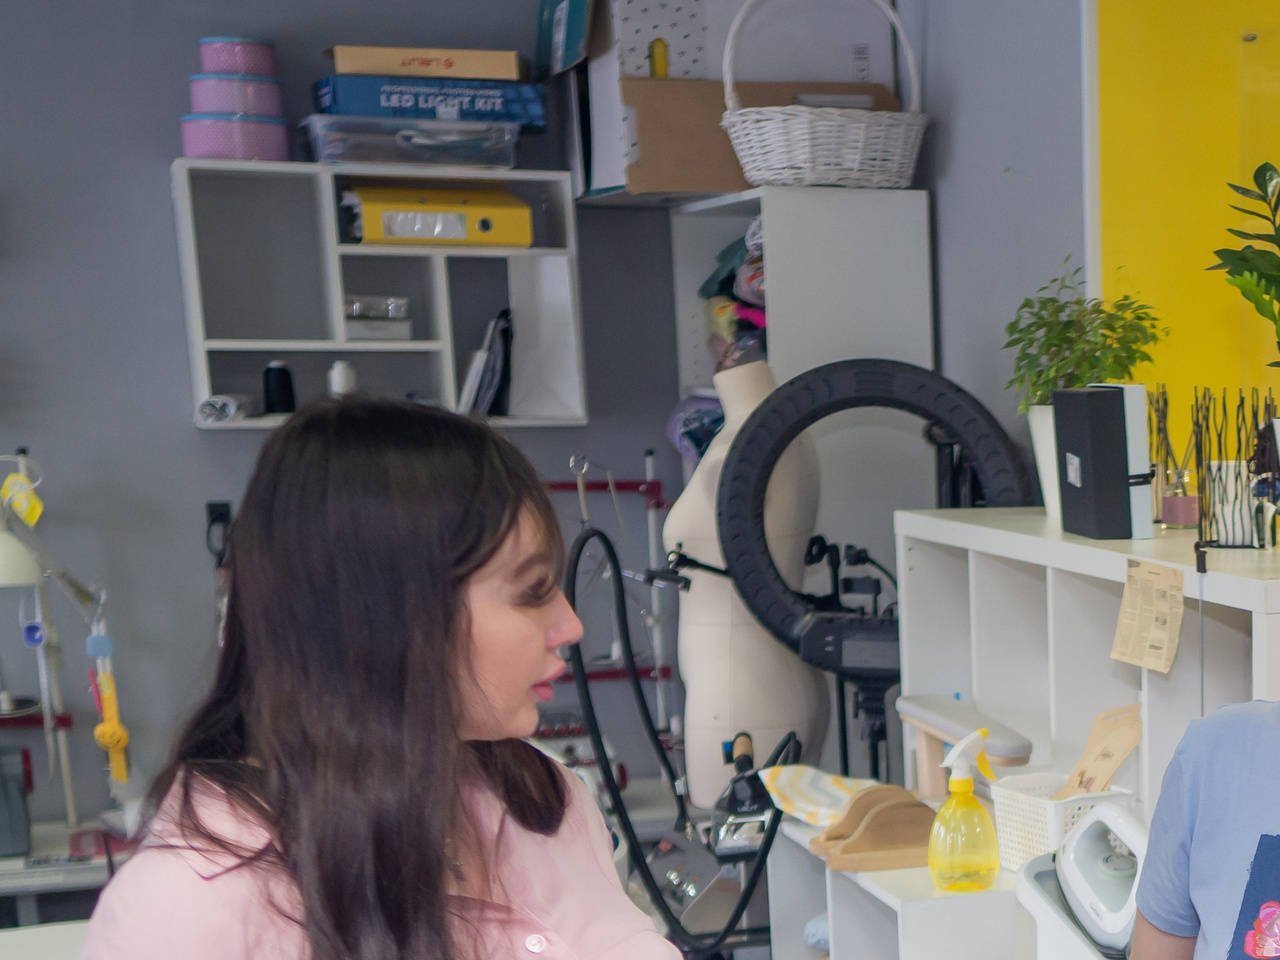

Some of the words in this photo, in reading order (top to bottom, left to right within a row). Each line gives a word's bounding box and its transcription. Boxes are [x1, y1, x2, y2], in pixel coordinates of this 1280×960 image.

[380, 93, 415, 108] LED
[418, 95, 472, 111] LIGHT
[474, 97, 505, 112] KIT
